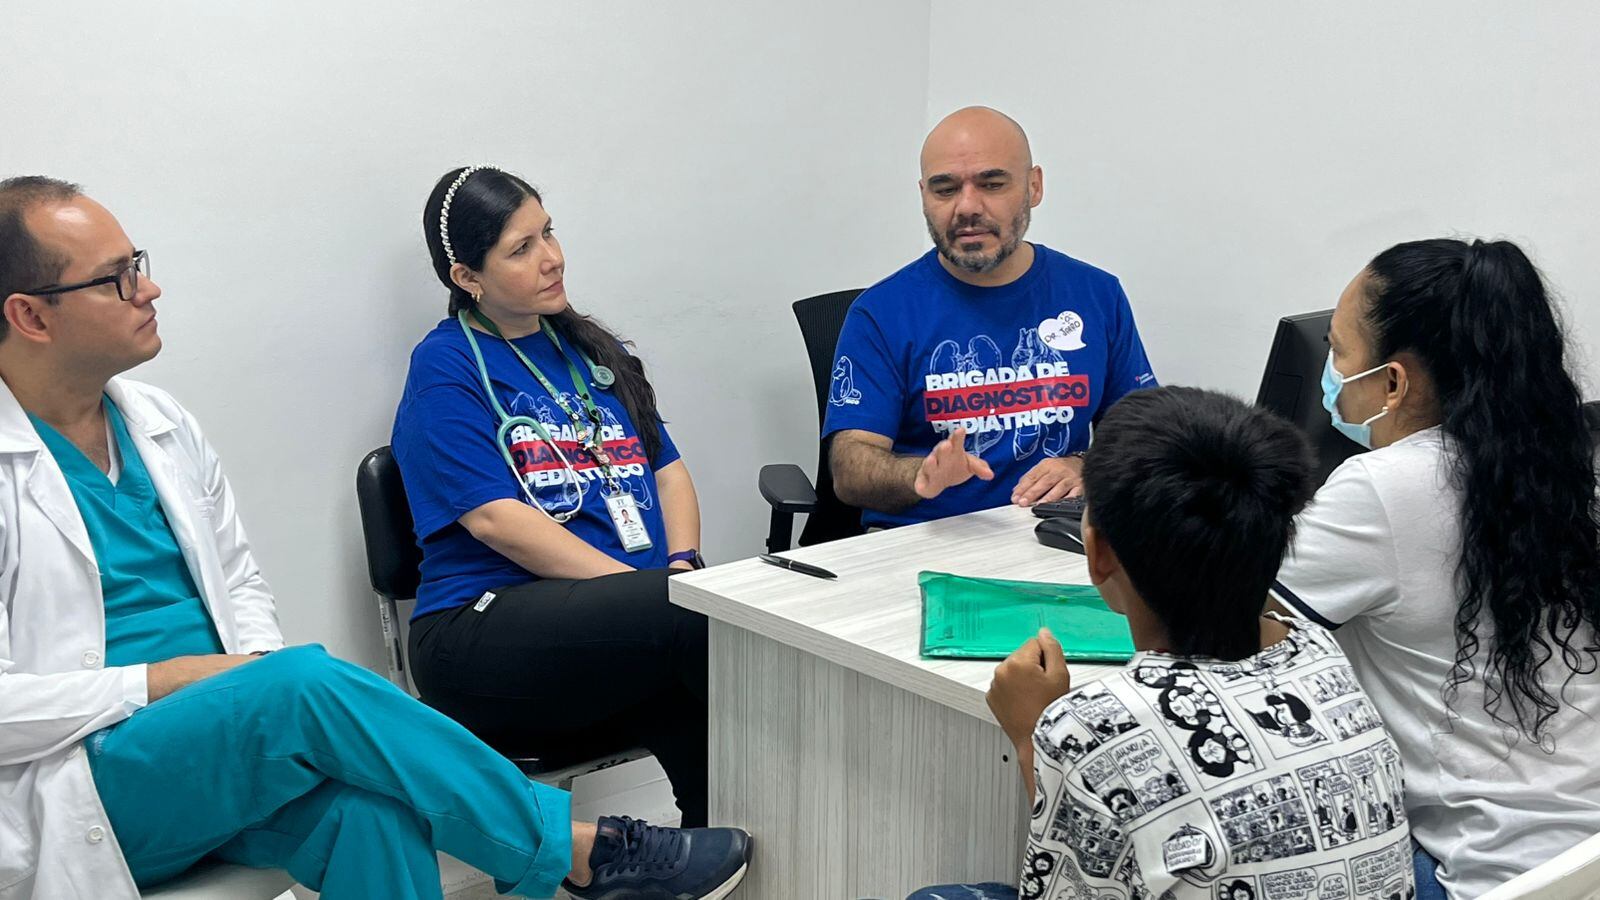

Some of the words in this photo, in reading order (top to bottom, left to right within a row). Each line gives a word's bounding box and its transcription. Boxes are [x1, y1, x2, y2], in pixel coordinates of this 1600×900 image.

[925, 365, 1034, 391] BRIGADA
[1036, 361, 1070, 379] DE
[926, 381, 1088, 415] DIAGNÓSTICO
[601, 424, 626, 441] DE
[931, 405, 1075, 435] PEDIÁTRICO
